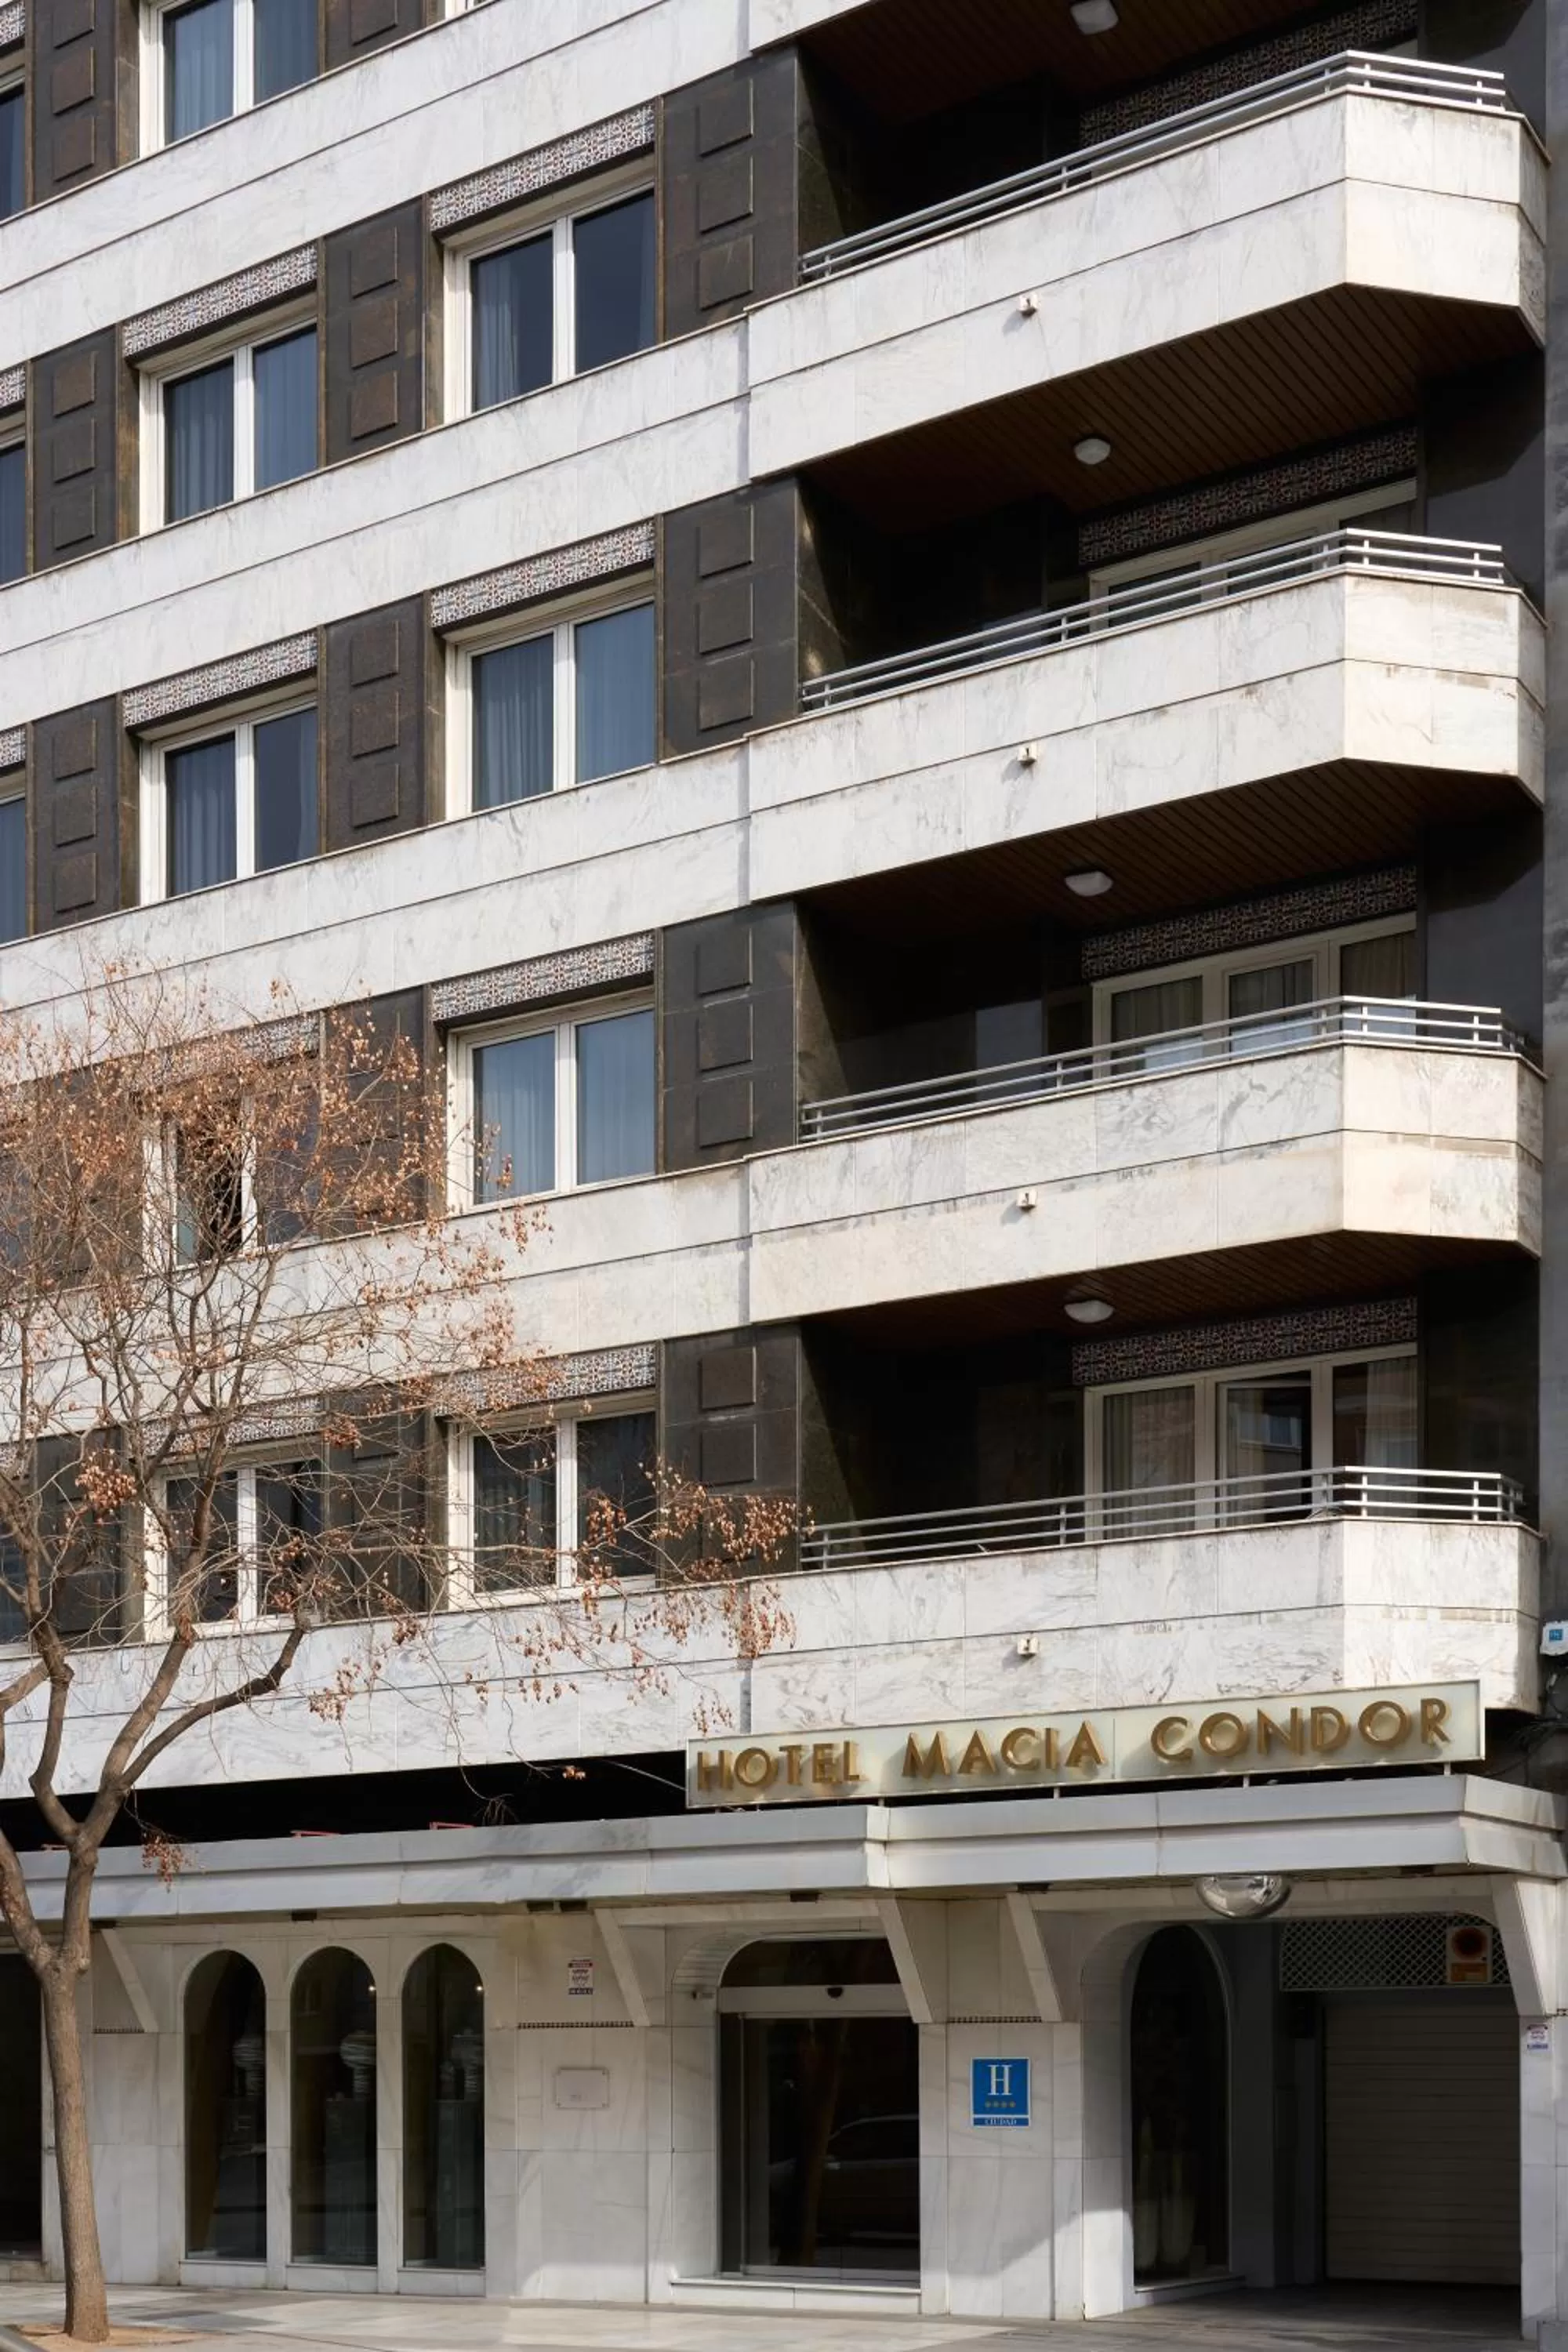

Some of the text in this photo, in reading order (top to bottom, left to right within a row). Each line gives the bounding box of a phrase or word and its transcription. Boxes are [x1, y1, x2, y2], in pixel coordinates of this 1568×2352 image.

[697, 1698, 1450, 1791] HOTEL MACIA CONDOR
[987, 2064, 1013, 2096] H
